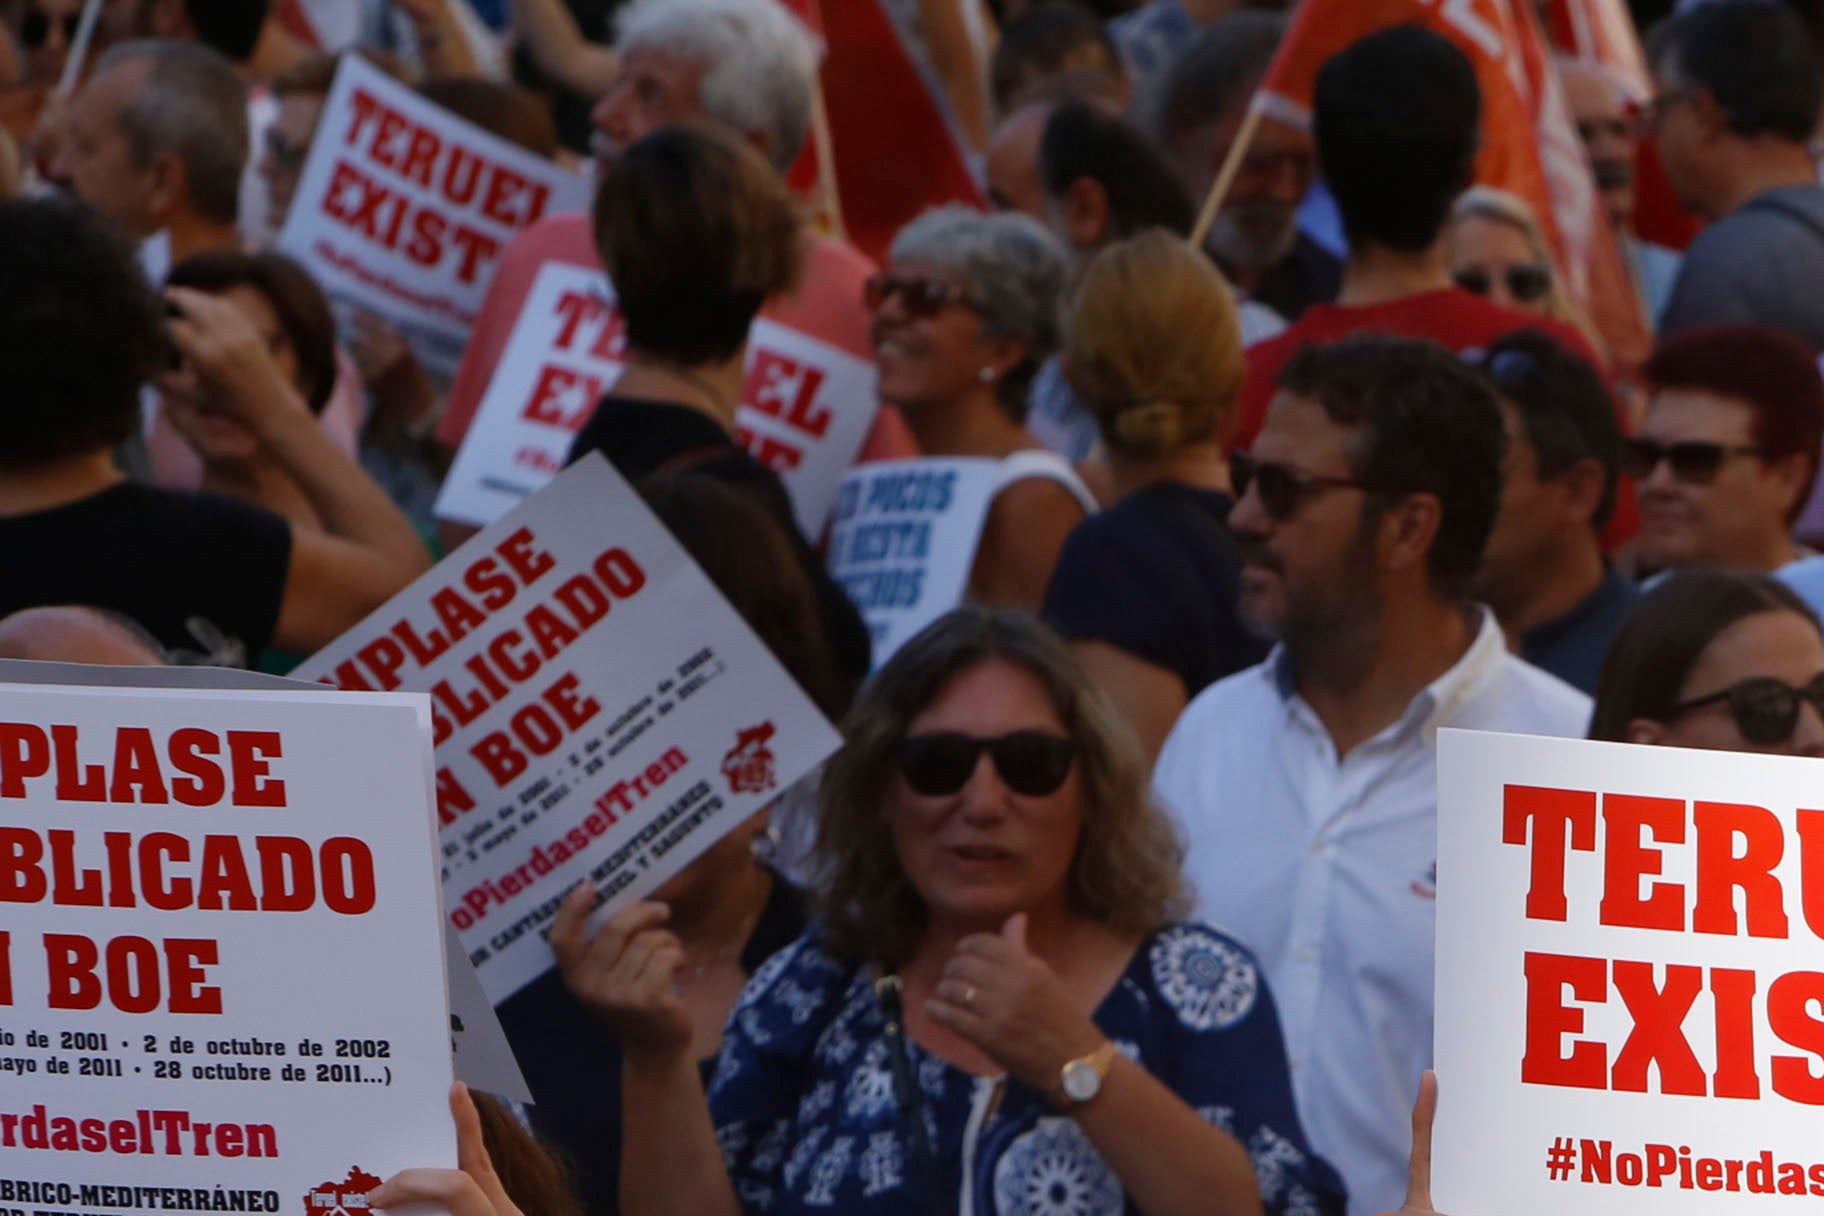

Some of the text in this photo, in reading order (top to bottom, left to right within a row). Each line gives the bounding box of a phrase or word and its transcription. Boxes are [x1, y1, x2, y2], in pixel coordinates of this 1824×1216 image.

[0, 722, 286, 807] PLASE
[469, 671, 603, 789] BOE
[0, 826, 376, 914] BLICADO
[43, 932, 223, 1014] BOE
[26, 1030, 49, 1048] de
[61, 1032, 107, 1051] 2001
[144, 1036, 157, 1053] 2
[170, 1036, 194, 1054] de
[207, 1038, 286, 1056] octubre
[298, 1039, 323, 1057] de
[335, 1040, 391, 1058] 2002
[47, 1056, 69, 1075] de
[79, 1057, 122, 1077] 2011
[154, 1061, 182, 1079] 28
[192, 1062, 271, 1082] octubre
[282, 1063, 306, 1082] de
[1, 1104, 279, 1158] rdaselTren
